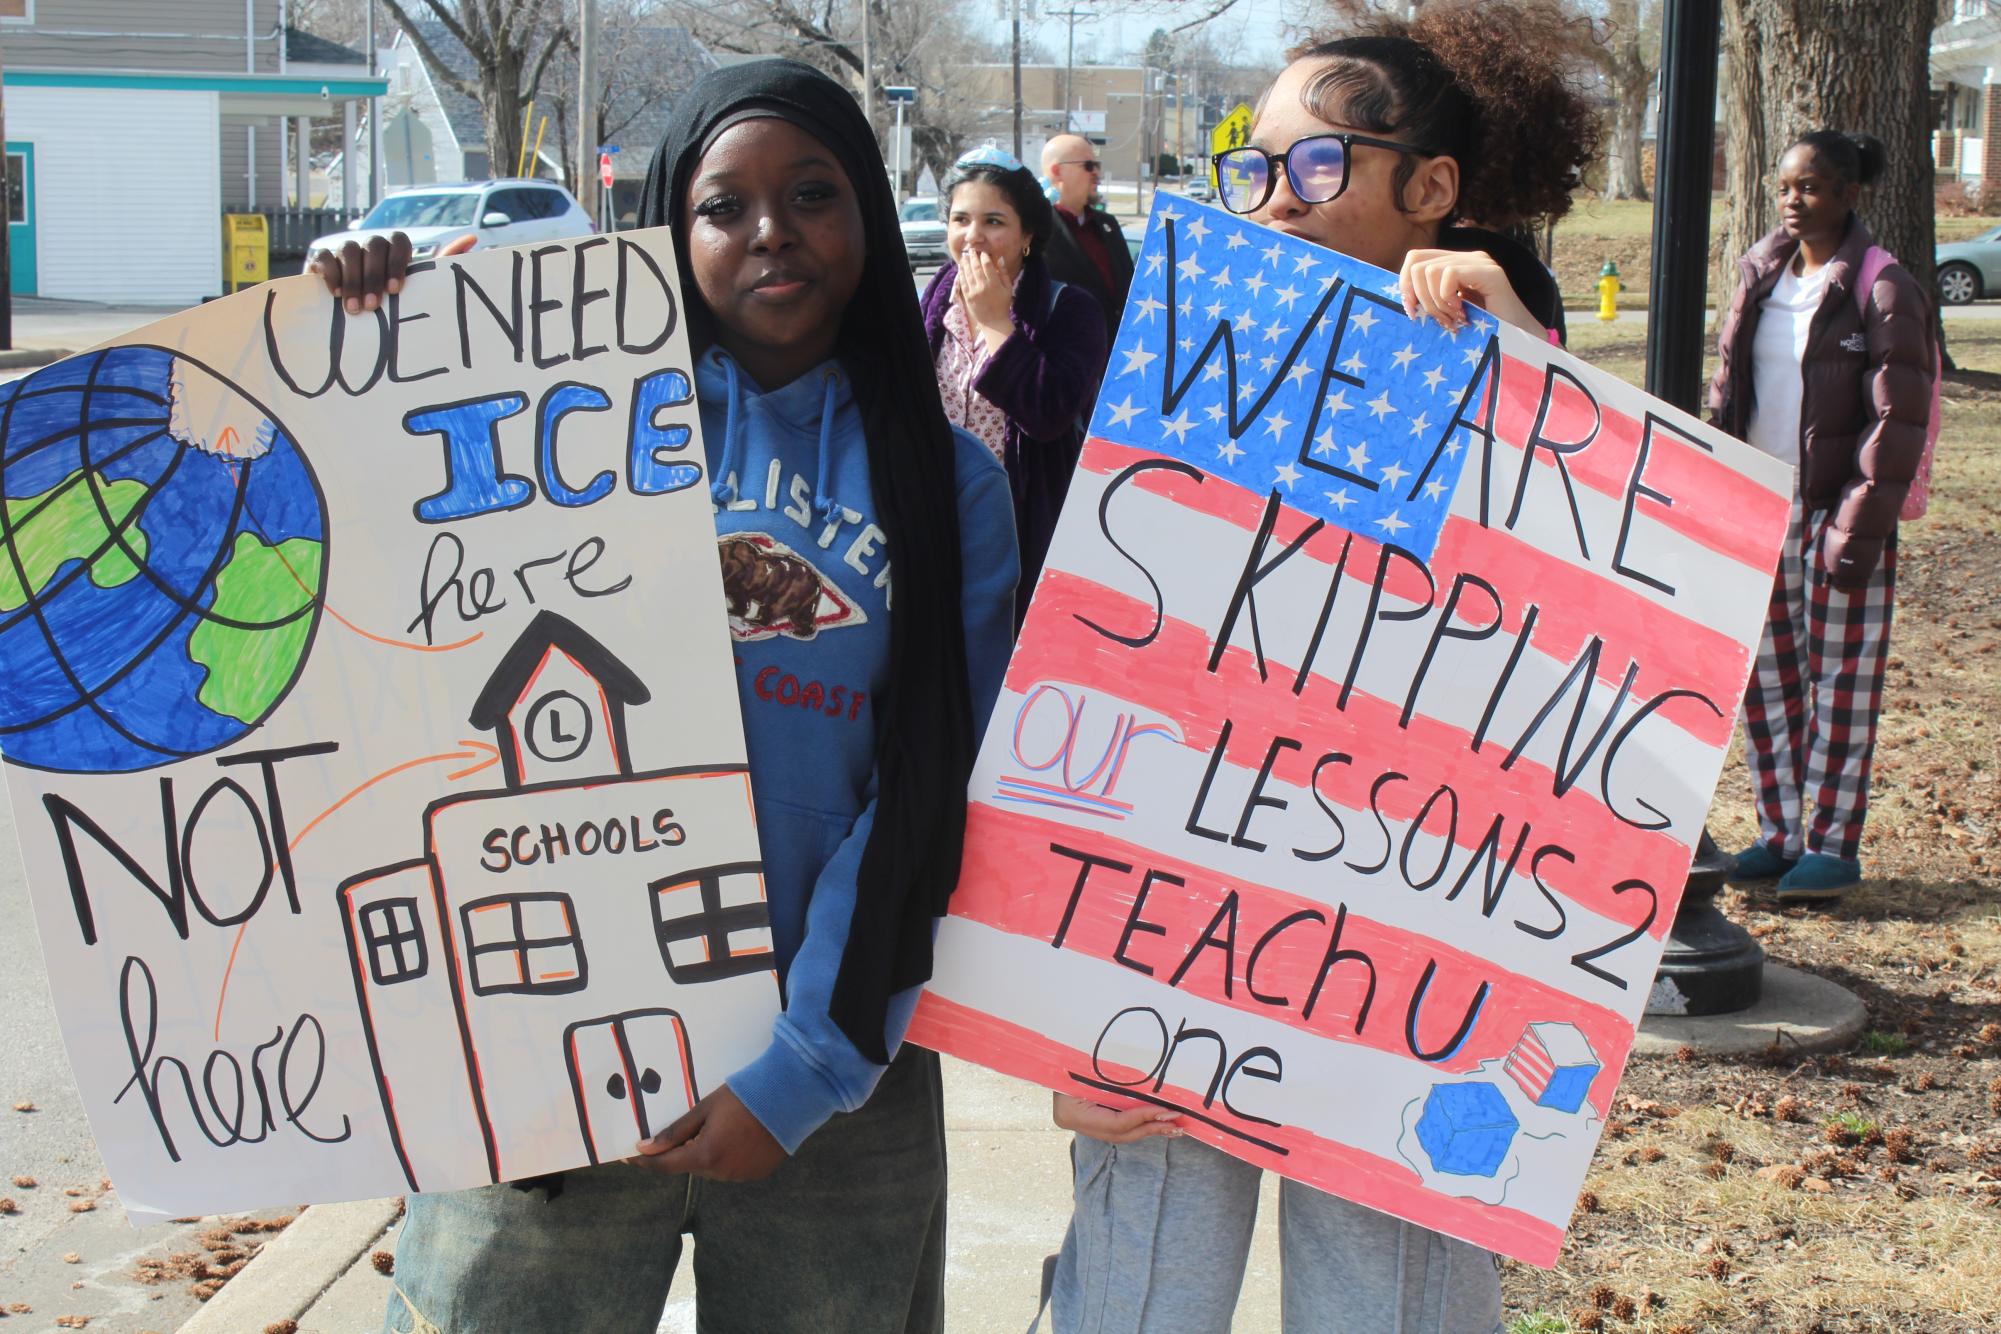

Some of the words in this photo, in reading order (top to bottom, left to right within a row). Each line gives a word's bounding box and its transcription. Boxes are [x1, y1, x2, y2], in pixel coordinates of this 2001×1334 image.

[263, 260, 449, 398] WE
[450, 238, 679, 371] NEED
[402, 368, 703, 524] ICE
[1160, 217, 1421, 492] WE
[1406, 334, 1714, 597] ARE
[406, 532, 633, 646] here
[711, 458, 892, 612] LISTE
[754, 664, 867, 721] COAST
[1072, 458, 1726, 832] SKIPPING
[42, 741, 340, 946] NOT
[480, 808, 687, 874] SCHOOLS
[1184, 720, 1576, 940] LESSONS
[1571, 878, 1658, 991] 2
[114, 955, 352, 1163] here
[1091, 1005, 1284, 1128] one
